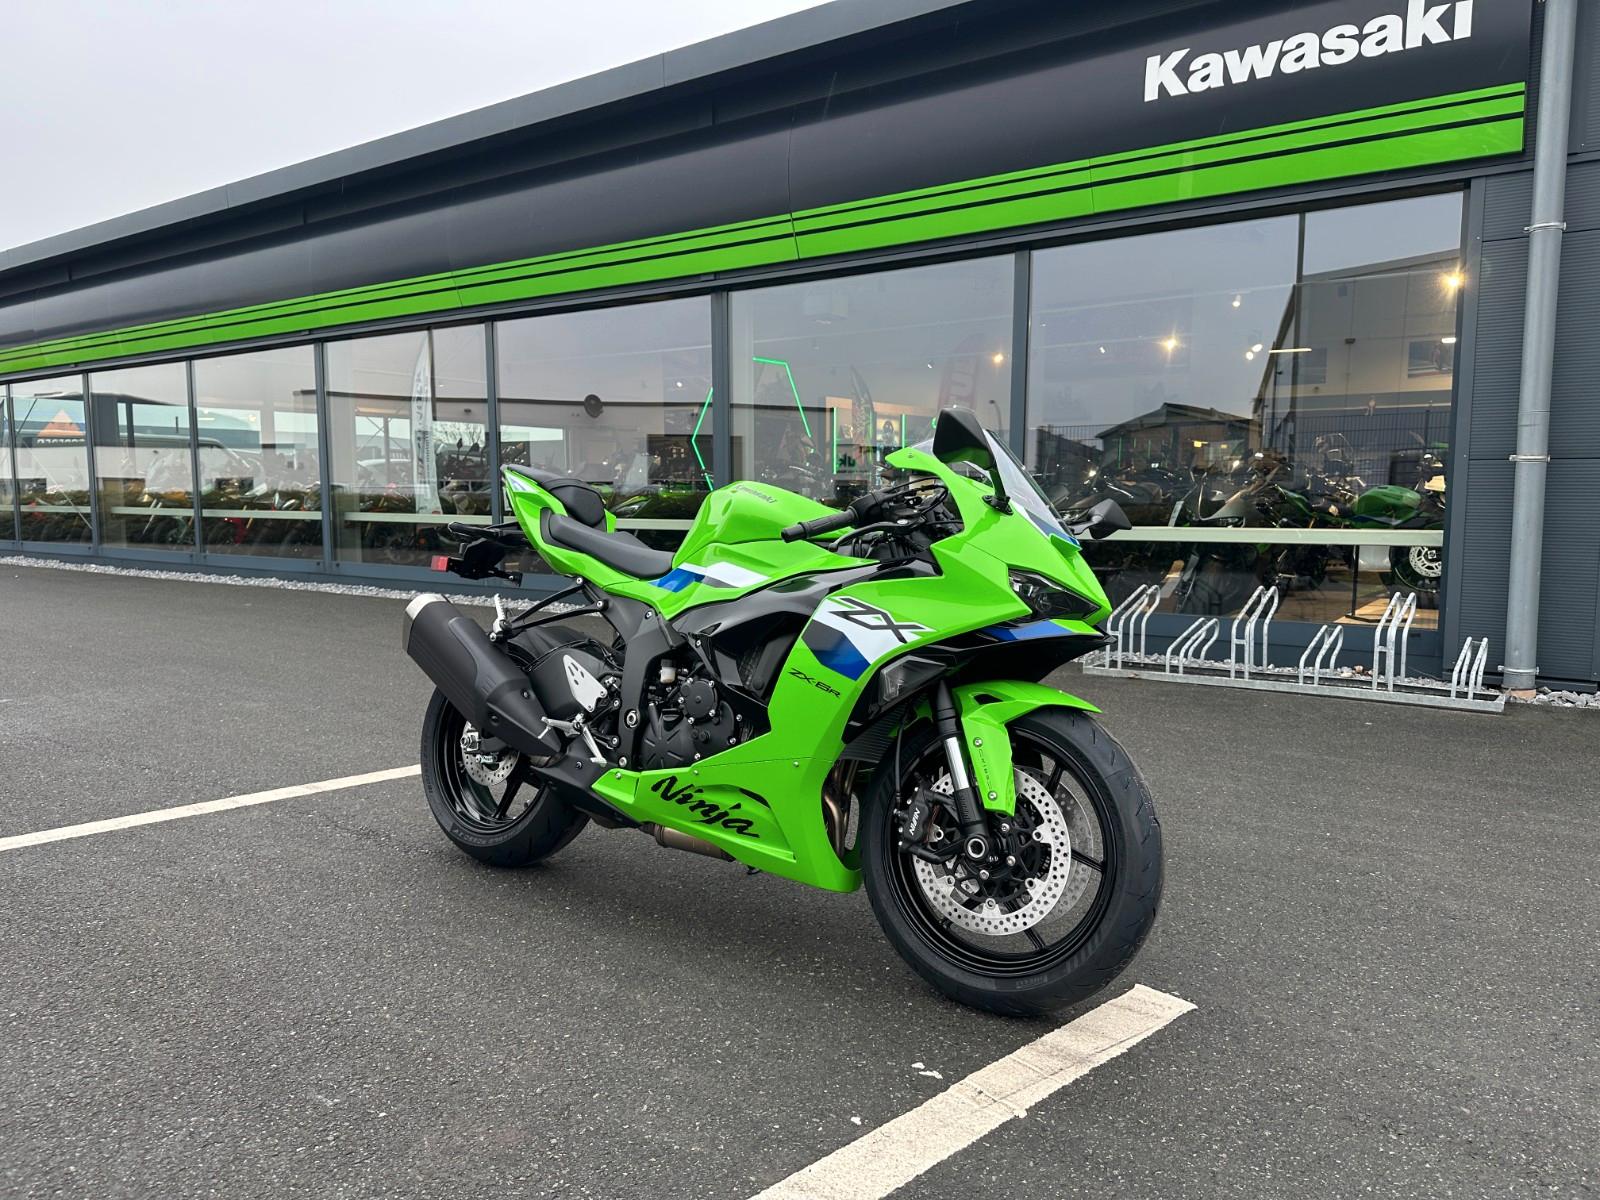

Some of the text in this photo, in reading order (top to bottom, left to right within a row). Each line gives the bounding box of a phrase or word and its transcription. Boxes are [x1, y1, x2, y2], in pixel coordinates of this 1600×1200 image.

[1143, 0, 1473, 103] Kawasaki
[827, 597, 927, 645] ZX
[788, 667, 841, 699] ZX-6R
[650, 775, 760, 838] Ninja
